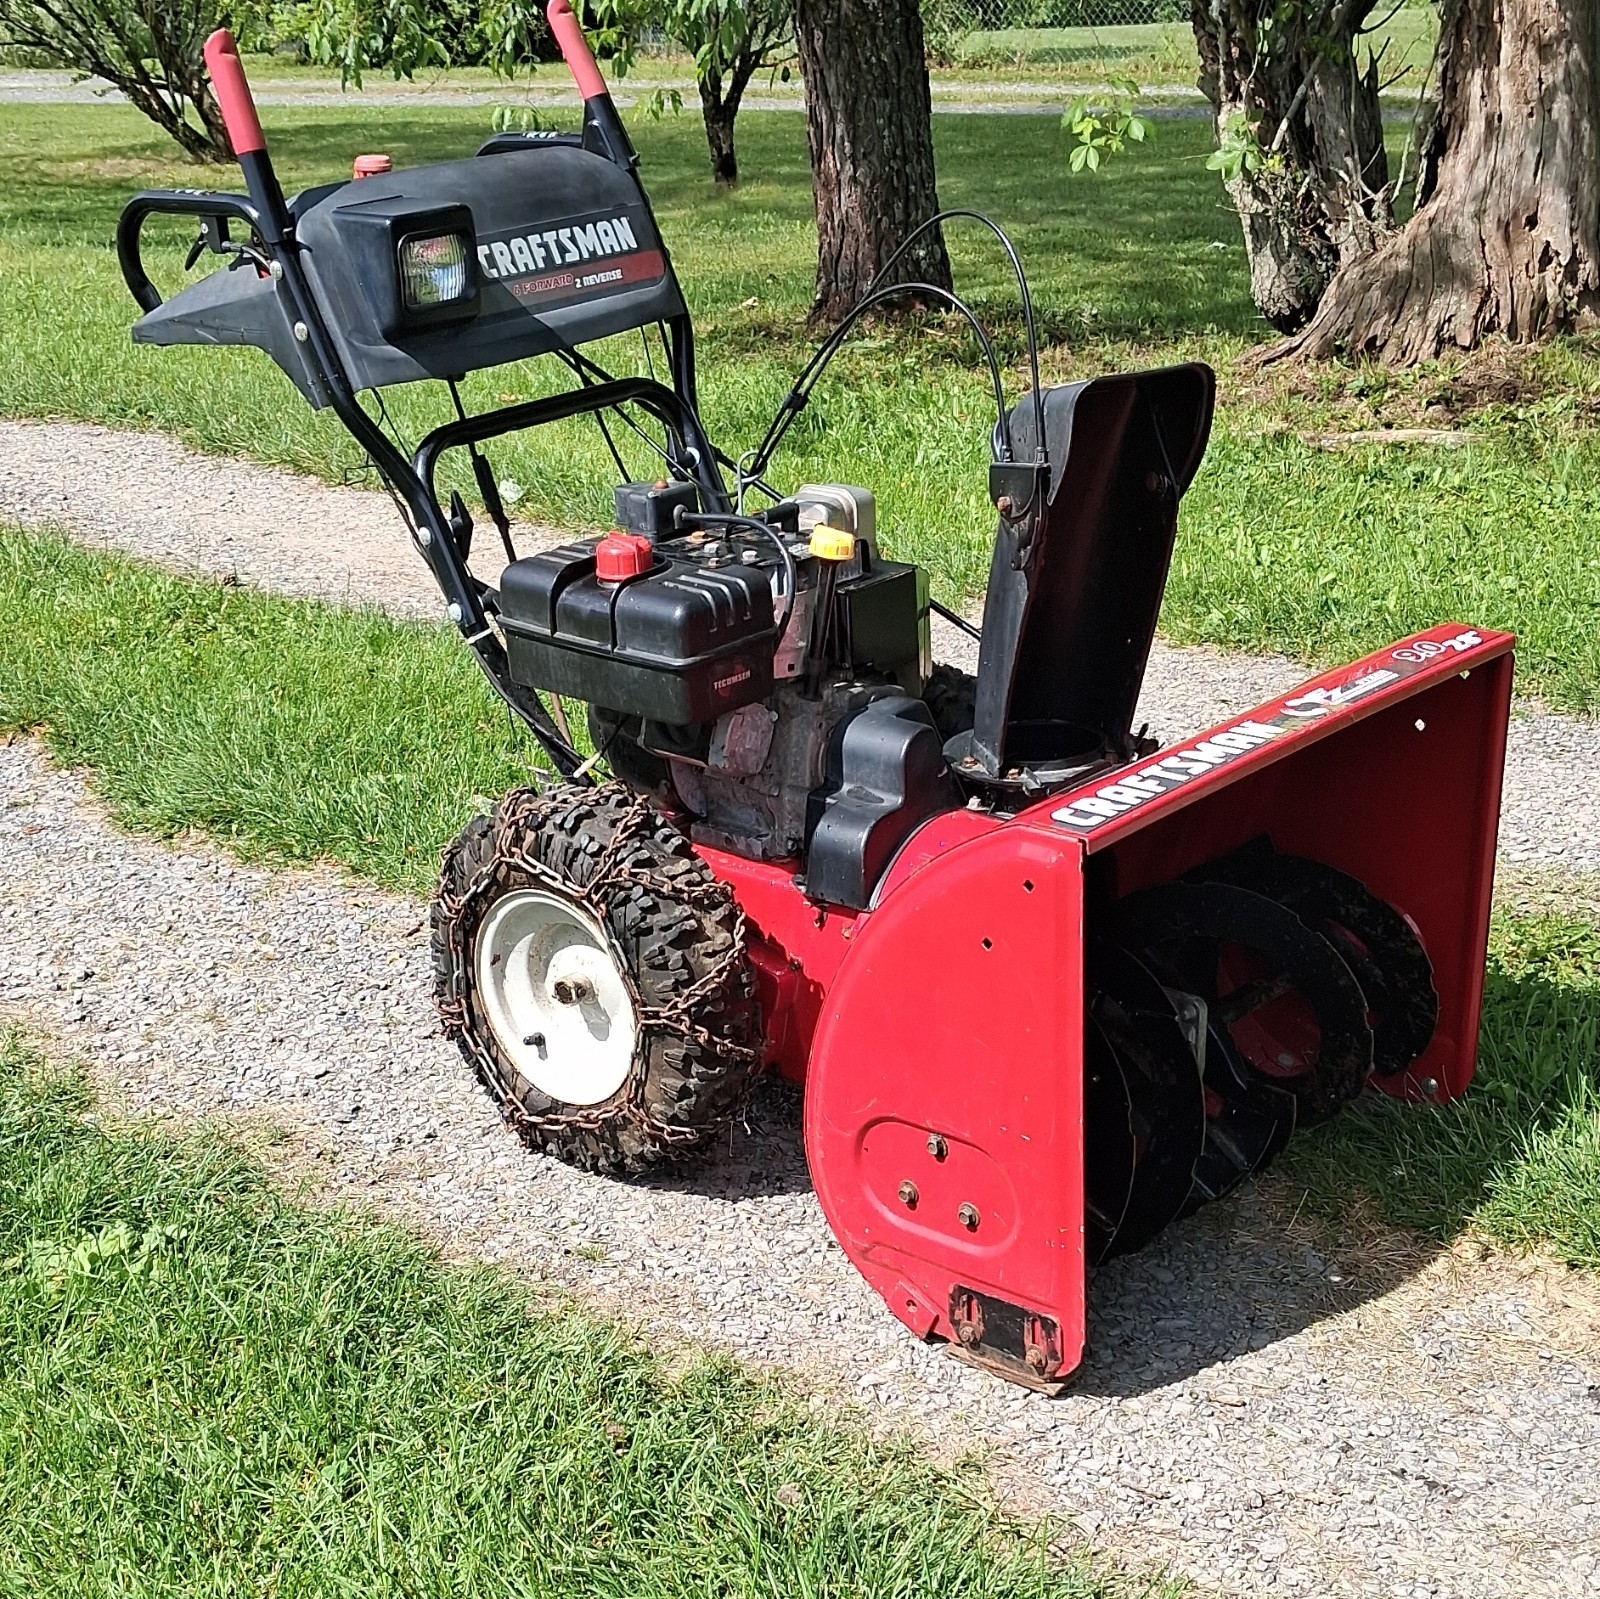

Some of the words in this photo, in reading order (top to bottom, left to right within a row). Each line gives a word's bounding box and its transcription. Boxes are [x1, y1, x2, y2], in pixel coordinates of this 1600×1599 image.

[477, 216, 638, 278] CRAFTSMAN
[523, 273, 574, 295] FORWARD
[574, 278, 582, 289] 2
[583, 269, 623, 287] REVERSE
[713, 669, 751, 690] TECUMSEH
[1050, 719, 1288, 827] CRAFTSMAN
